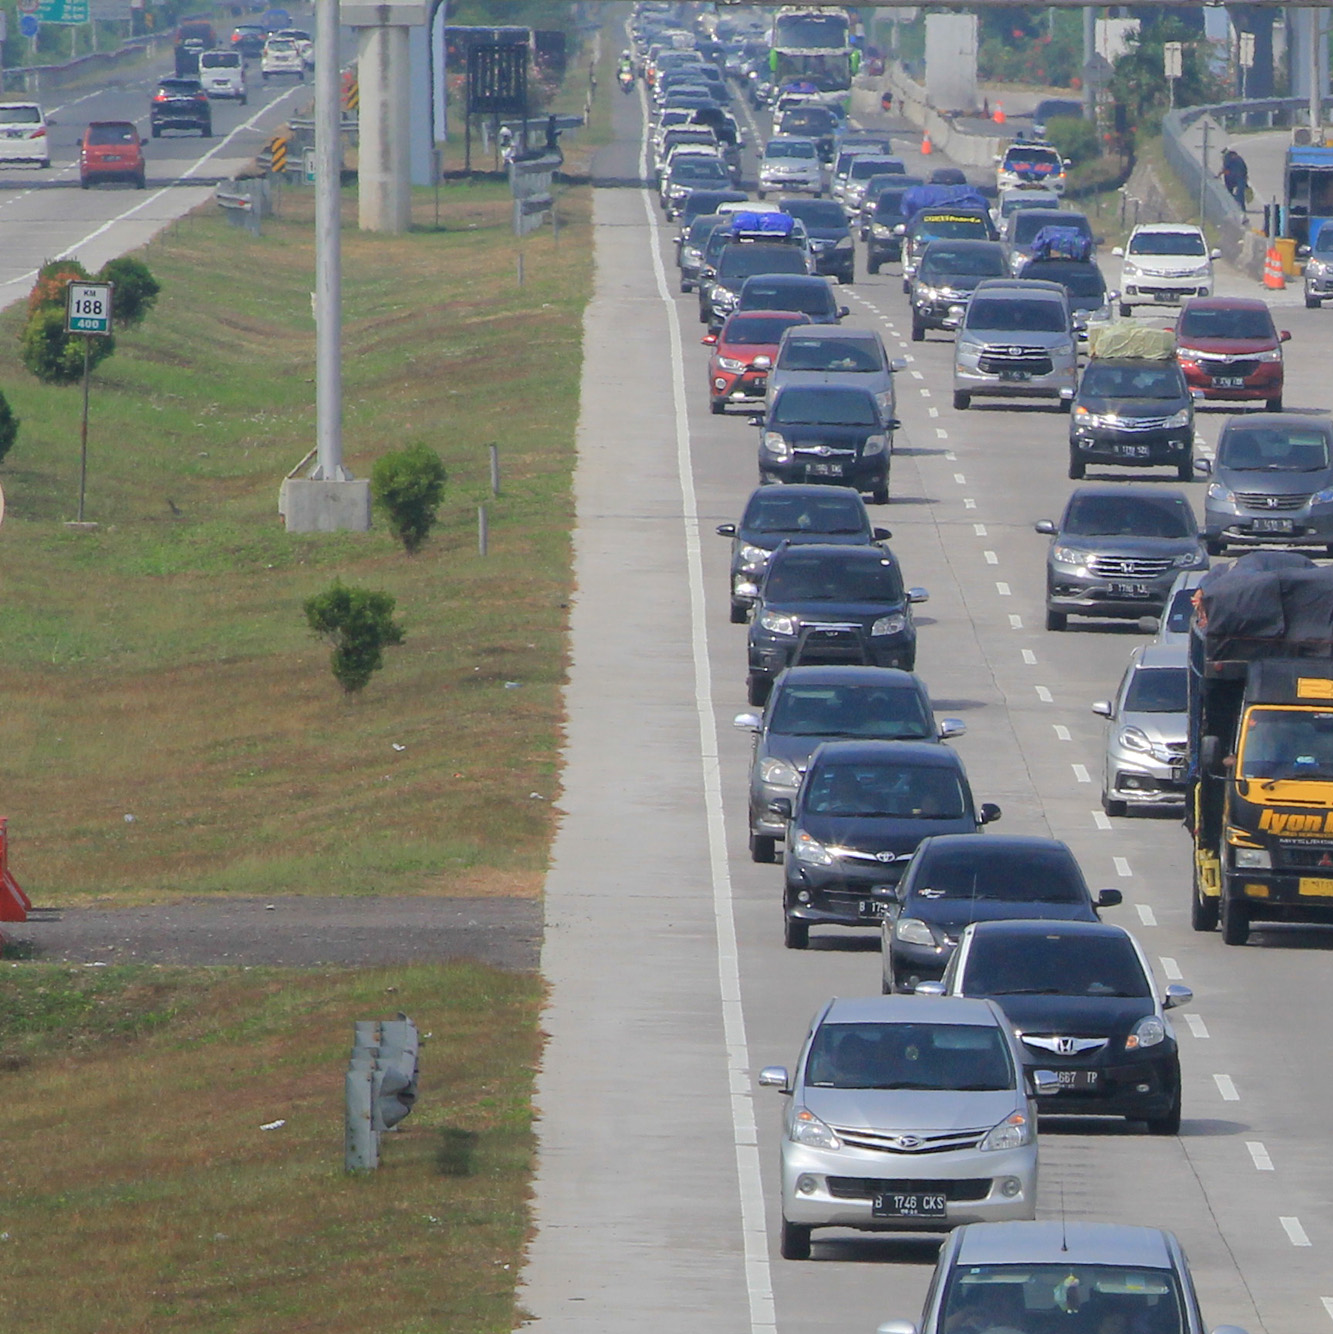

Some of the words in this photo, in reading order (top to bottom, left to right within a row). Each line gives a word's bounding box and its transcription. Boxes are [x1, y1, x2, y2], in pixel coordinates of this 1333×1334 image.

[75, 300, 102, 315] 188
[77, 319, 99, 328] 400
[875, 1195, 882, 1208] B
[894, 1195, 917, 1209] 1746
[923, 1196, 944, 1209] CKS
